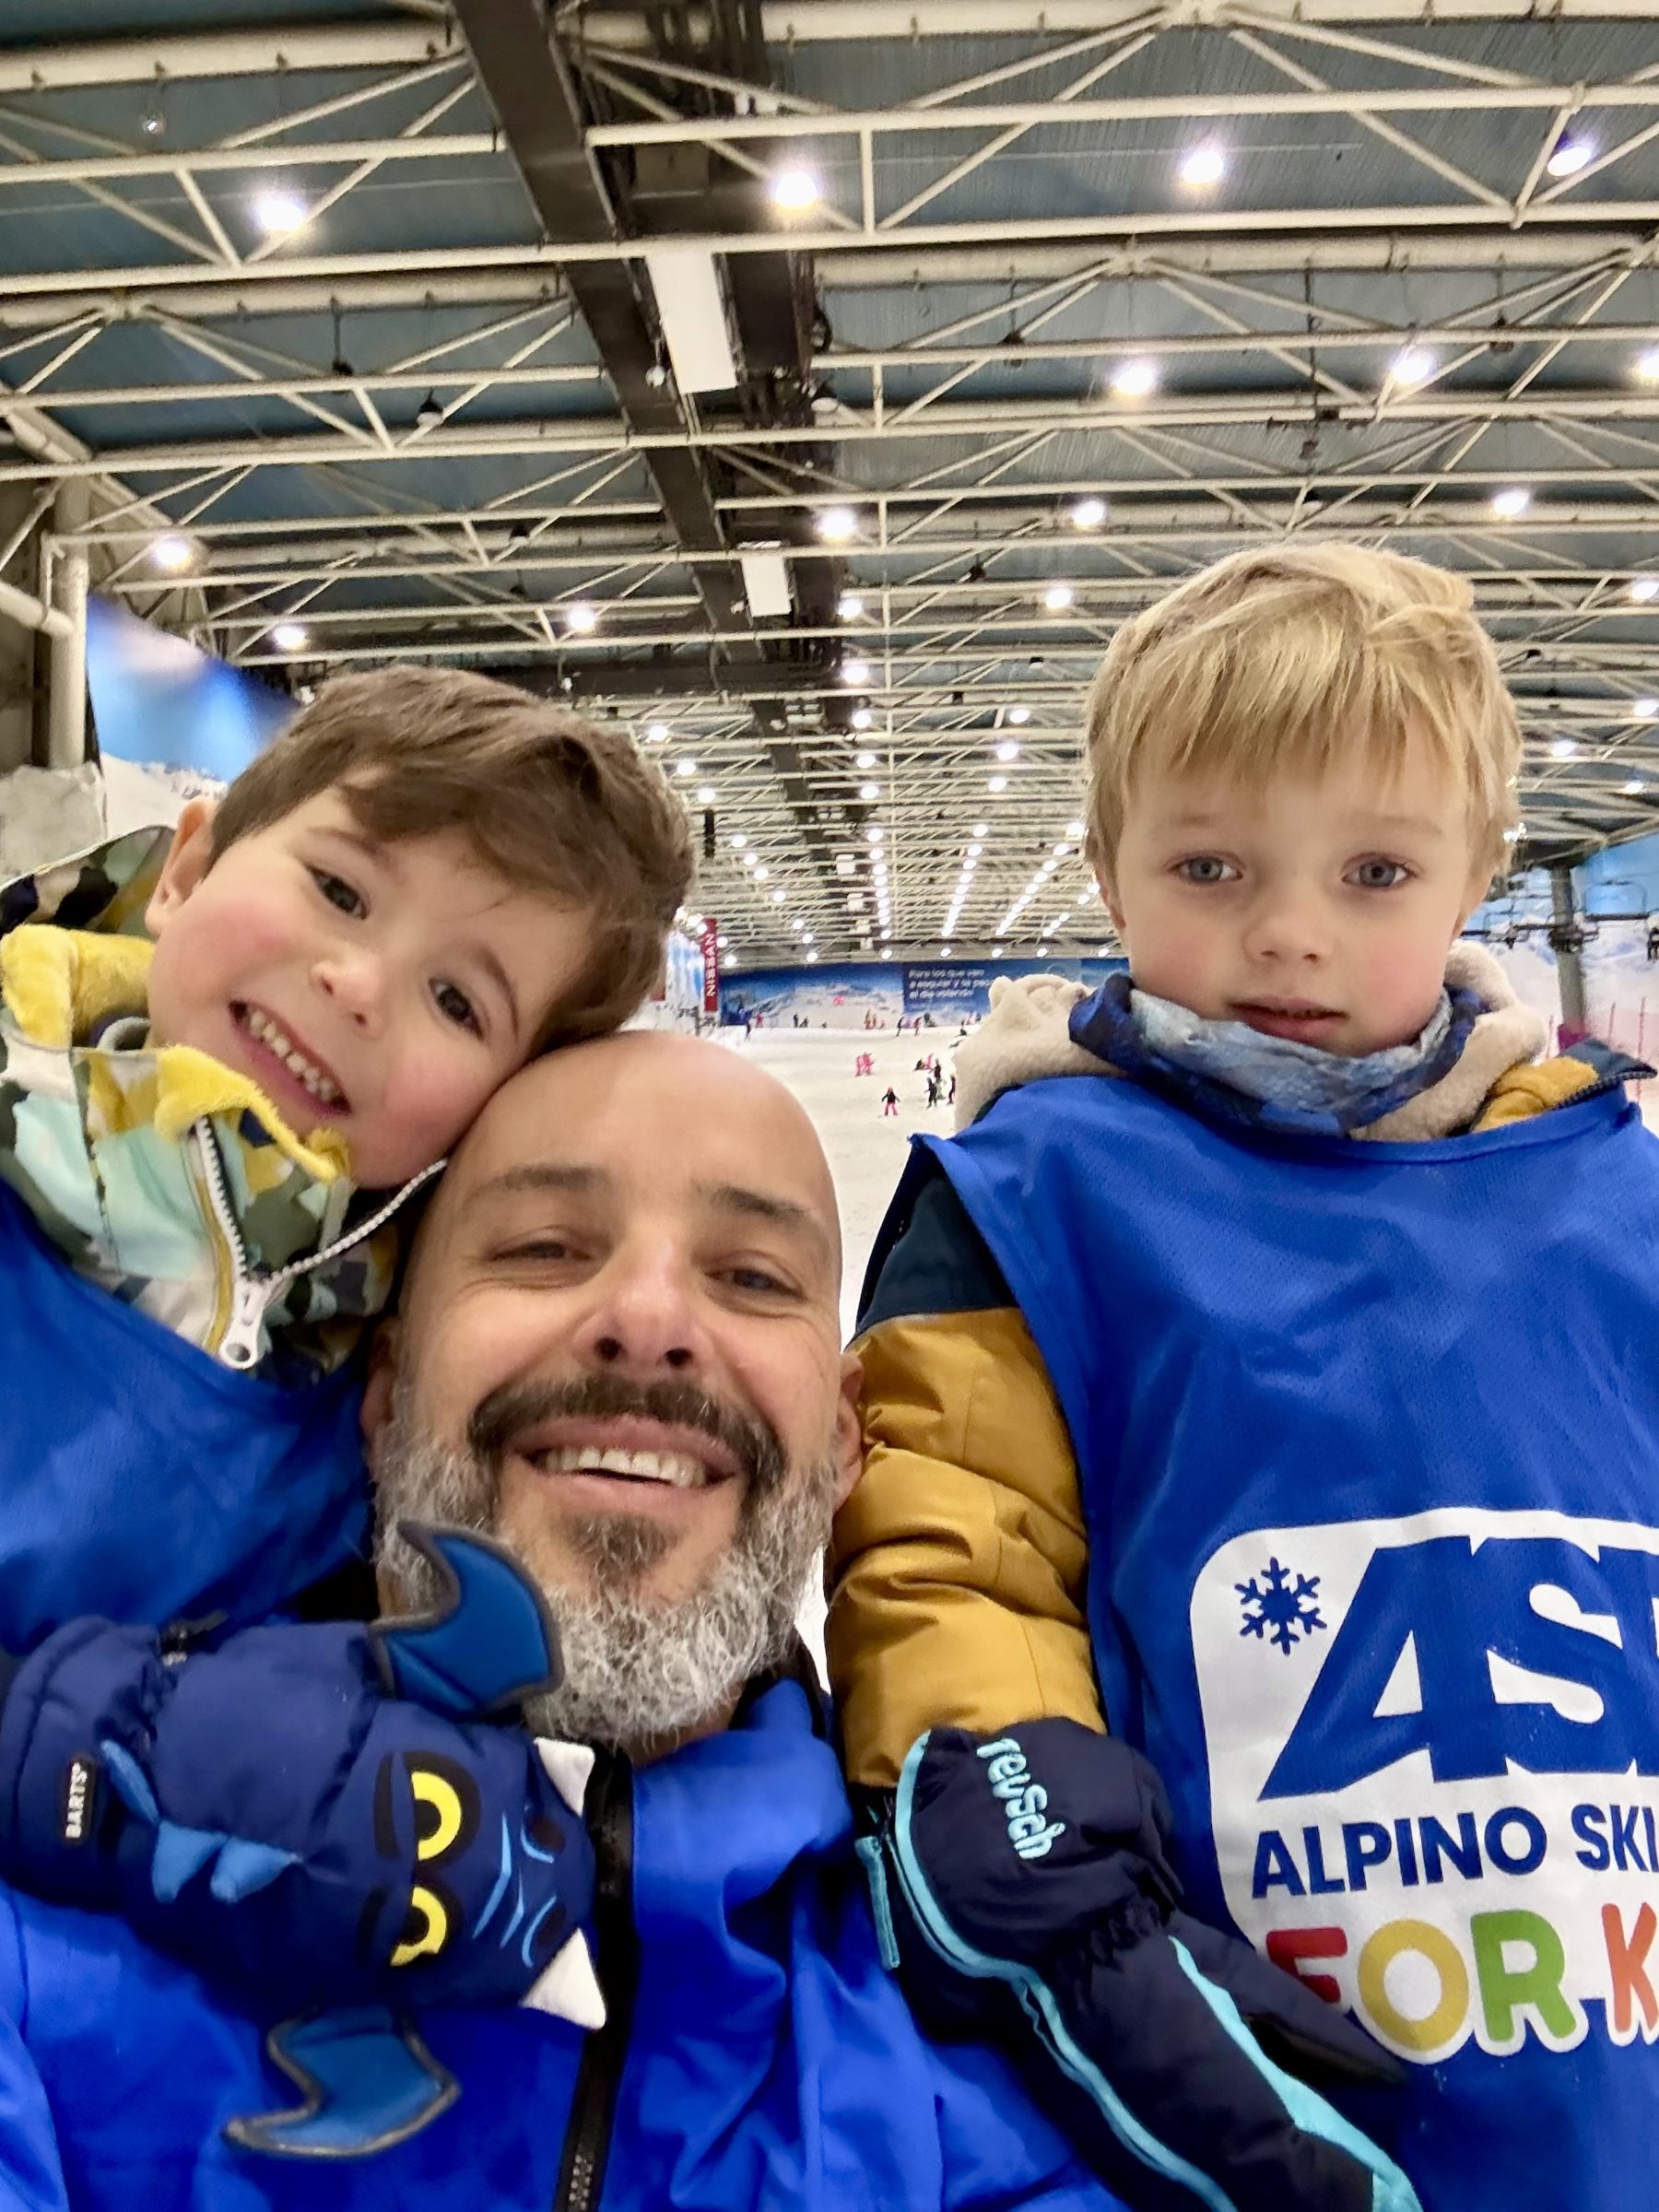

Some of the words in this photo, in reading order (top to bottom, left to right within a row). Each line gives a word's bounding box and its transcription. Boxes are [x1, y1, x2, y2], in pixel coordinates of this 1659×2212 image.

[704, 933, 717, 997] NISSAN
[976, 1738, 1066, 1859] reusch
[1252, 1806, 1547, 1900] ALPINO
[1571, 1804, 1659, 1873] SKI
[1265, 1909, 1577, 2052] FOR
